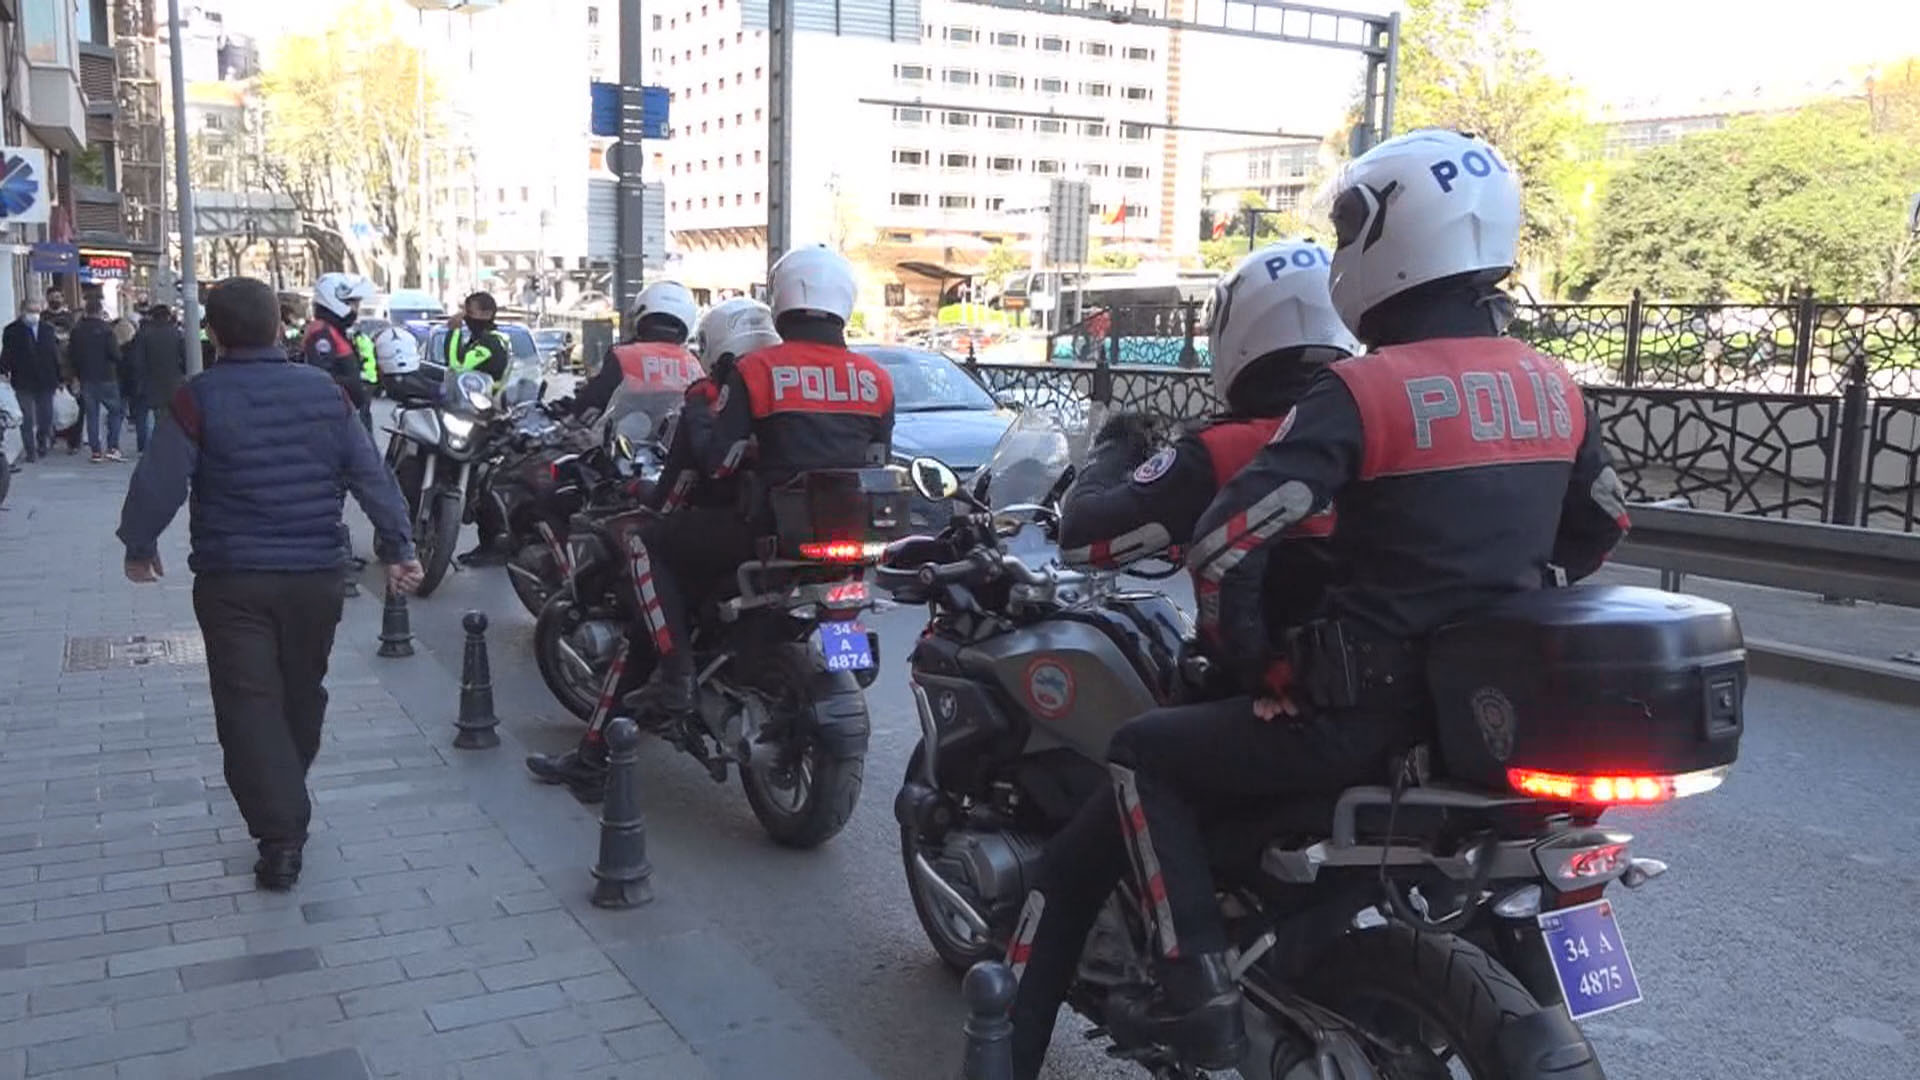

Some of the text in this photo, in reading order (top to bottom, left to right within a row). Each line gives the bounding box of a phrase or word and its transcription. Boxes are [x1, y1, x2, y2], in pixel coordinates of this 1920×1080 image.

[89, 257, 127, 267] HOTEL
[92, 268, 122, 277] SUITE
[771, 362, 879, 402] POLİS
[1404, 358, 1572, 450] POLİS
[832, 623, 850, 635] 34
[840, 639, 852, 651] A
[828, 653, 871, 669] 4874
[1564, 932, 1614, 962] 34 A
[1579, 966, 1623, 996] 4875
